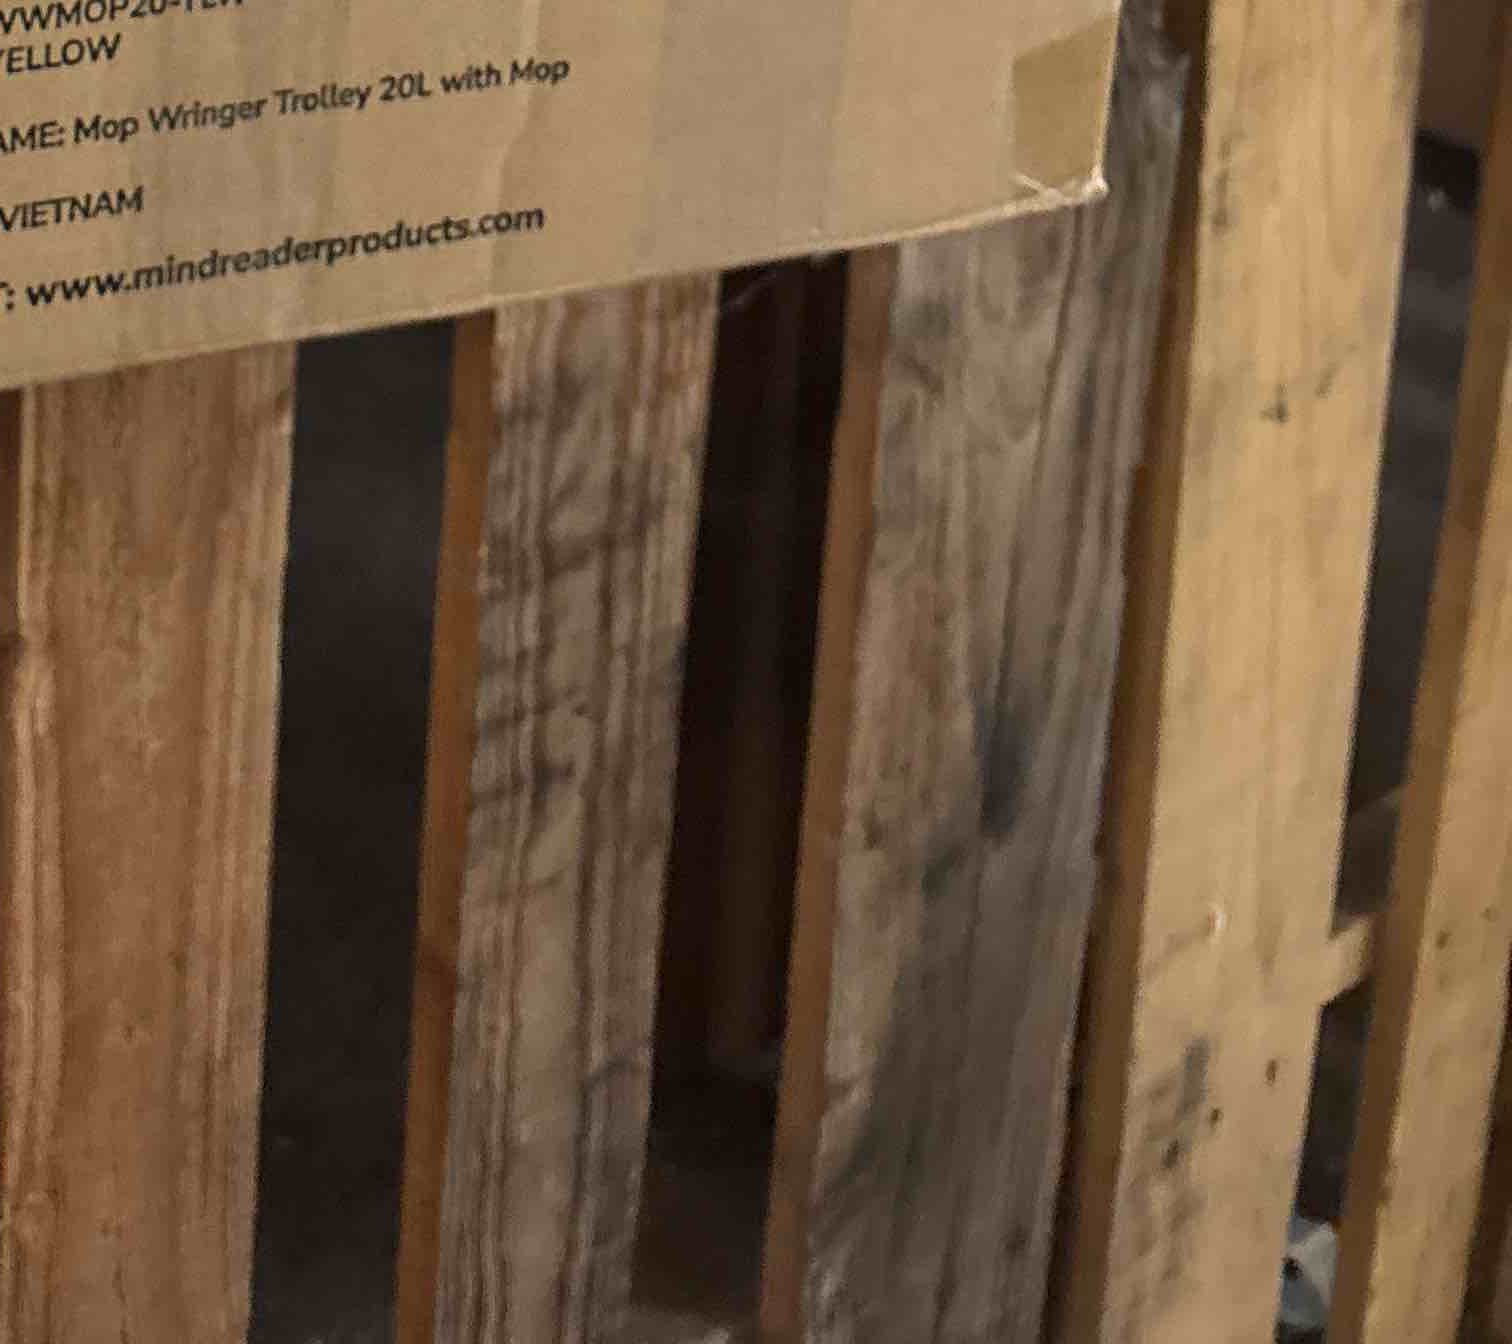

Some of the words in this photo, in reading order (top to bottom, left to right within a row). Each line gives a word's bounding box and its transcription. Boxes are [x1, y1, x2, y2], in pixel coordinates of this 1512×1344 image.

[73, 114, 140, 145] Mop
[147, 98, 268, 133] Wringer
[273, 82, 373, 115] Trolley
[379, 71, 433, 103] 20L
[439, 61, 502, 94] with
[508, 57, 571, 87] Mop
[24, 207, 545, 307] www.mindreaderproducts.com
